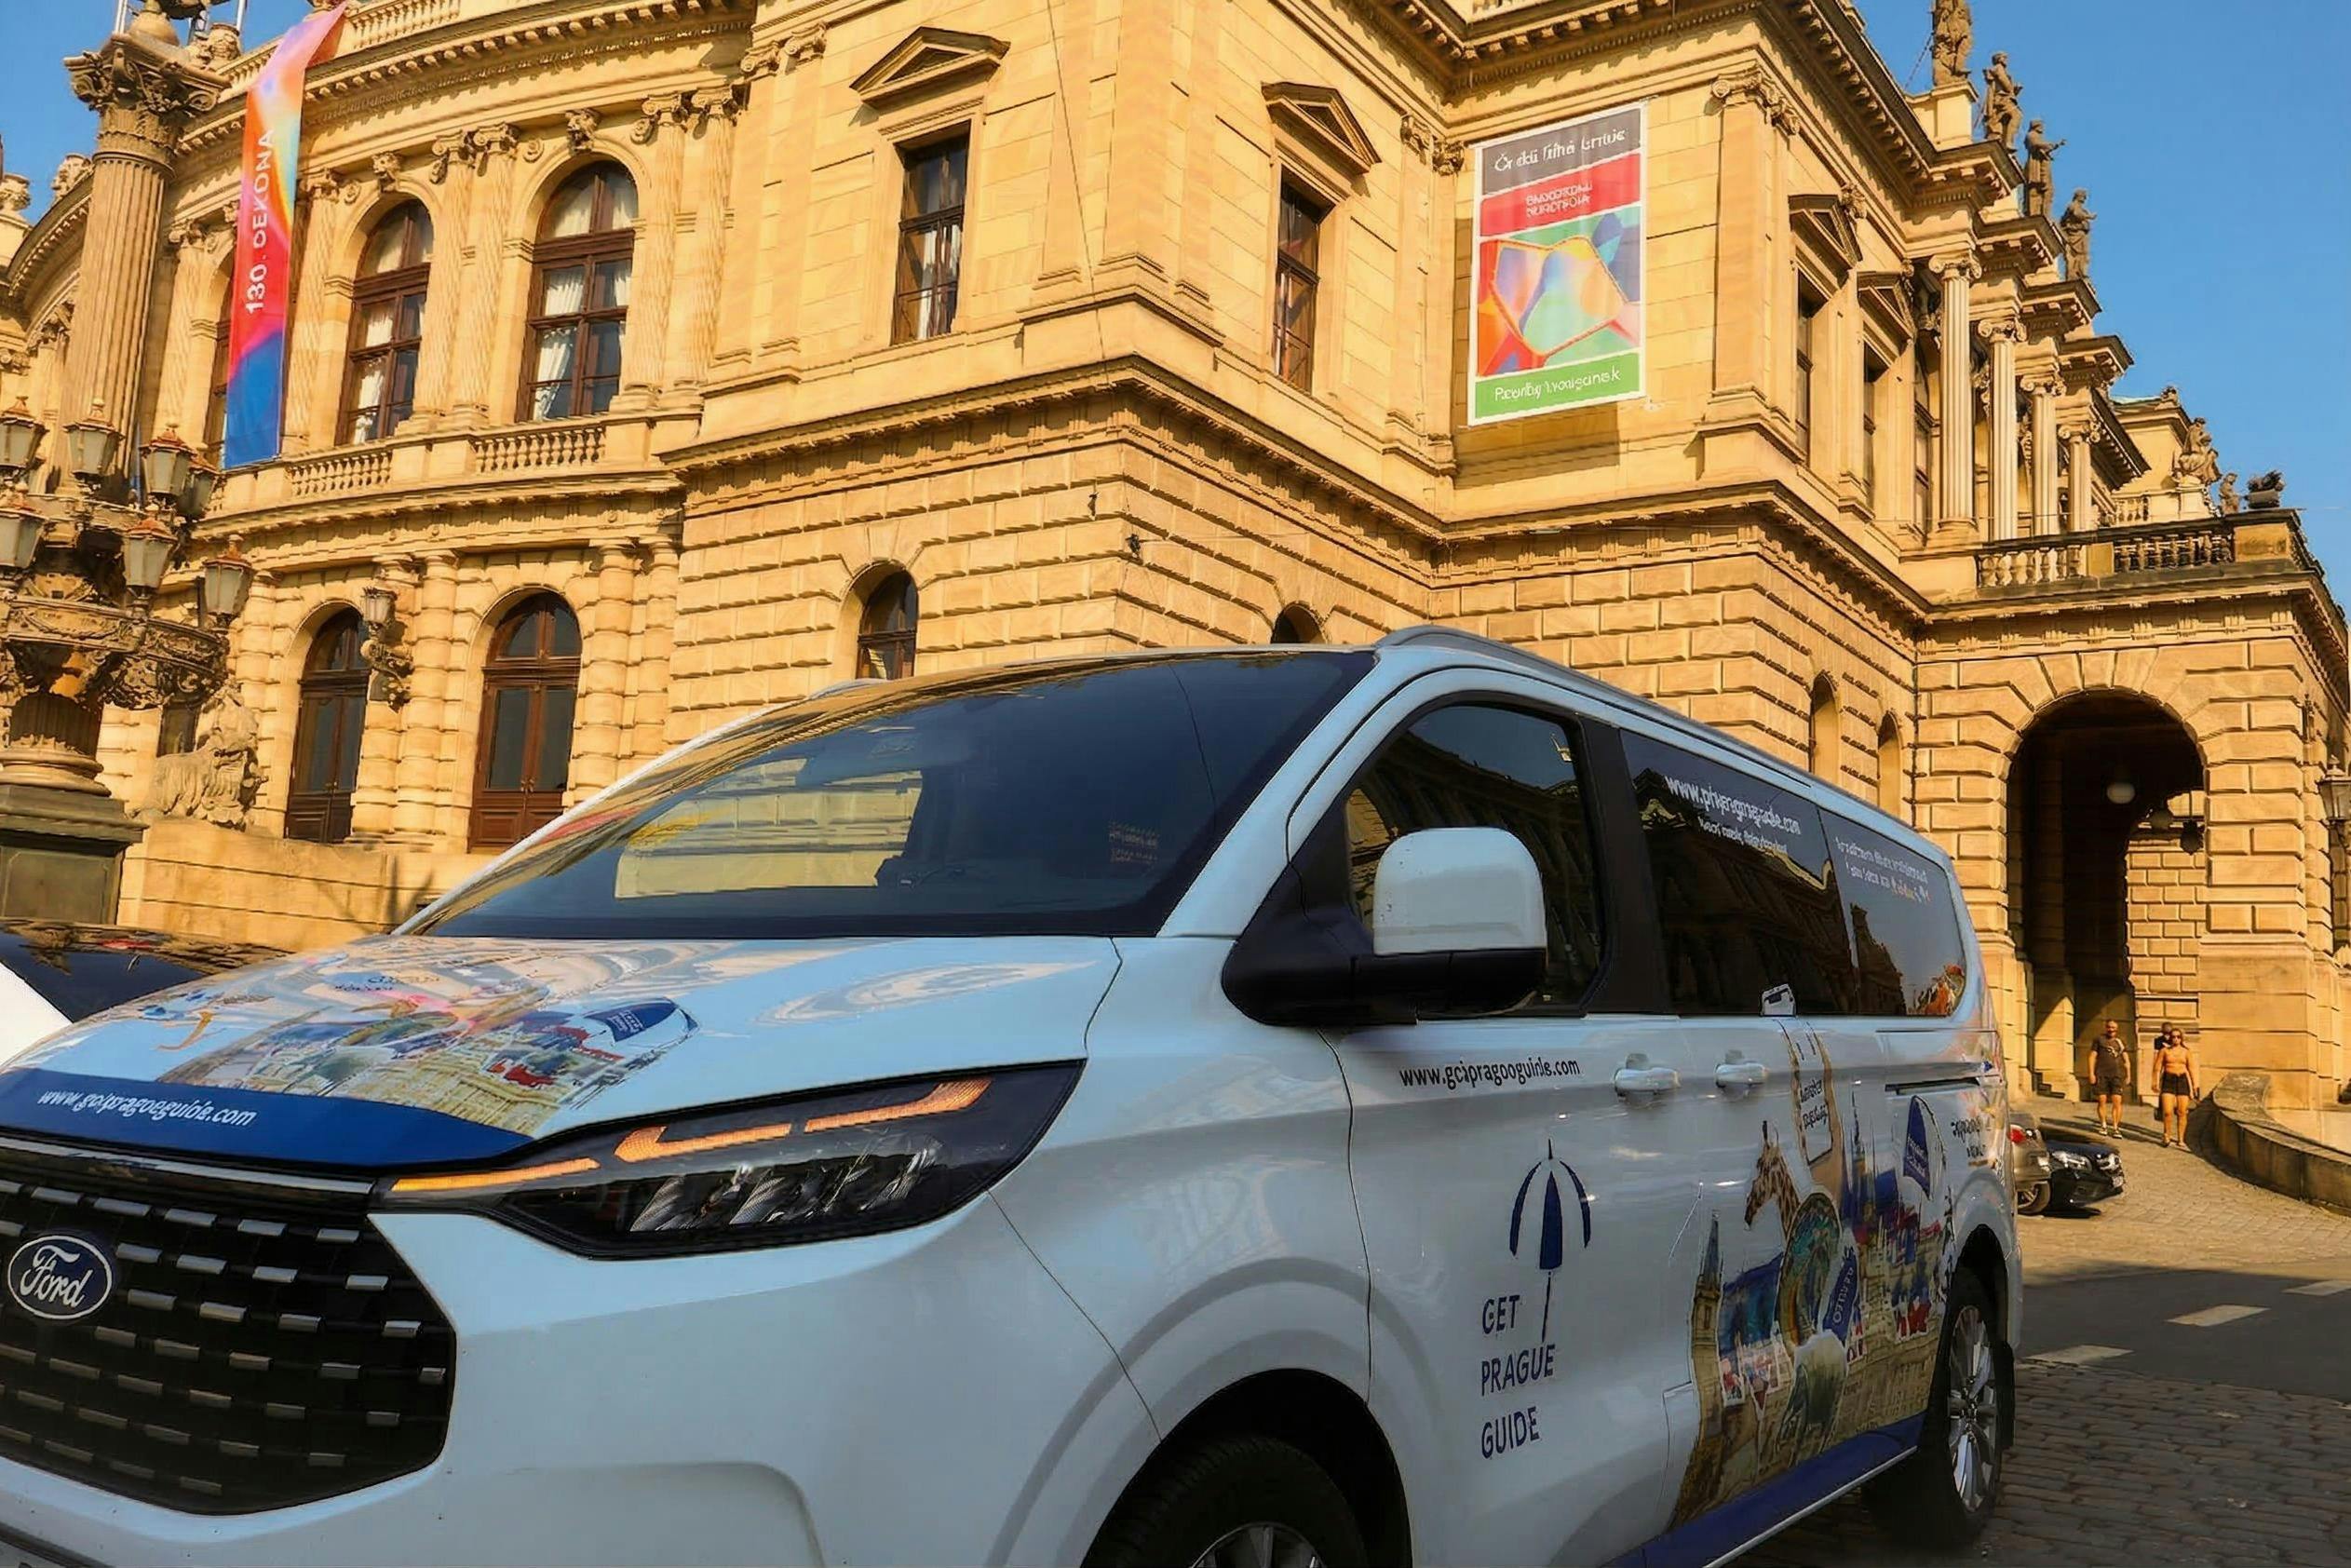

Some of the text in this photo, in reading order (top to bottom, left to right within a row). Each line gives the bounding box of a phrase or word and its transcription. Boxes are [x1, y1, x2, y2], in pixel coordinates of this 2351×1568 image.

[20, 1244, 94, 1308] Ford
[1481, 1294, 1520, 1335] GET
[1480, 1344, 1556, 1397] PRAGUE
[1480, 1406, 1540, 1460] GUIDE
